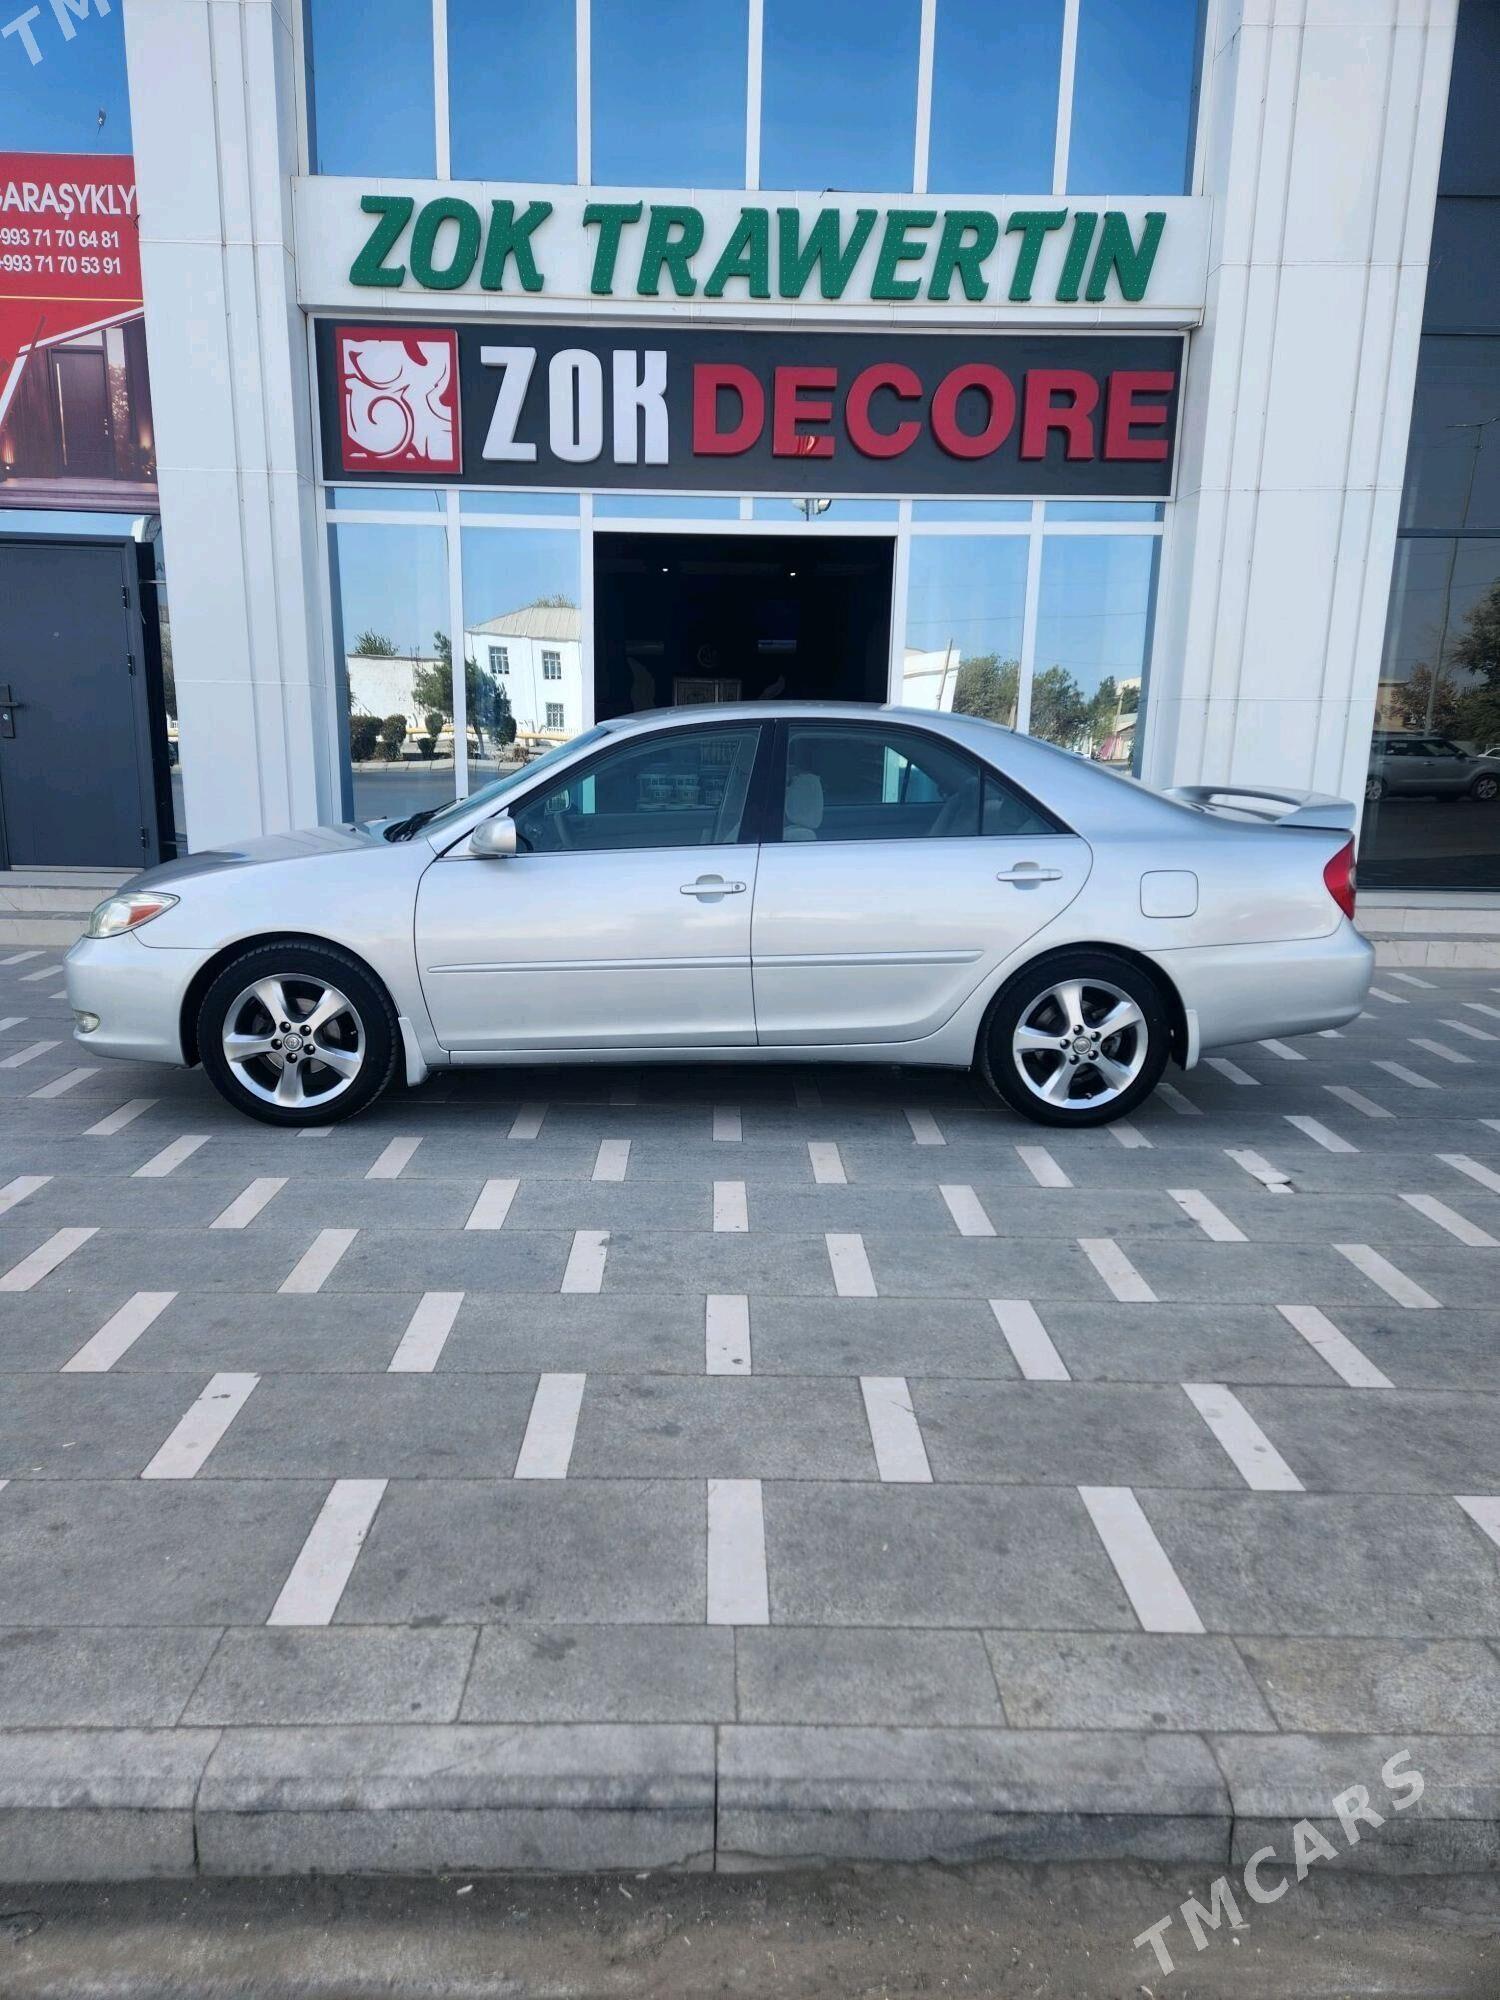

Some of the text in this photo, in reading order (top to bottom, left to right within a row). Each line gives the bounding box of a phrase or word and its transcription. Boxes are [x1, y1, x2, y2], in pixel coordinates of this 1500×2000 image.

[0, 181, 136, 220] ARAŞYKLY
[0, 228, 119, 248] 993 71 70 64 81
[349, 195, 1167, 302] ZOK TRAWERTIN
[35, 255, 53, 273] 71
[57, 256, 78, 273] 70
[80, 256, 100, 274] 53
[103, 257, 121, 274] 91
[480, 345, 1175, 465] ZOK DECORE
